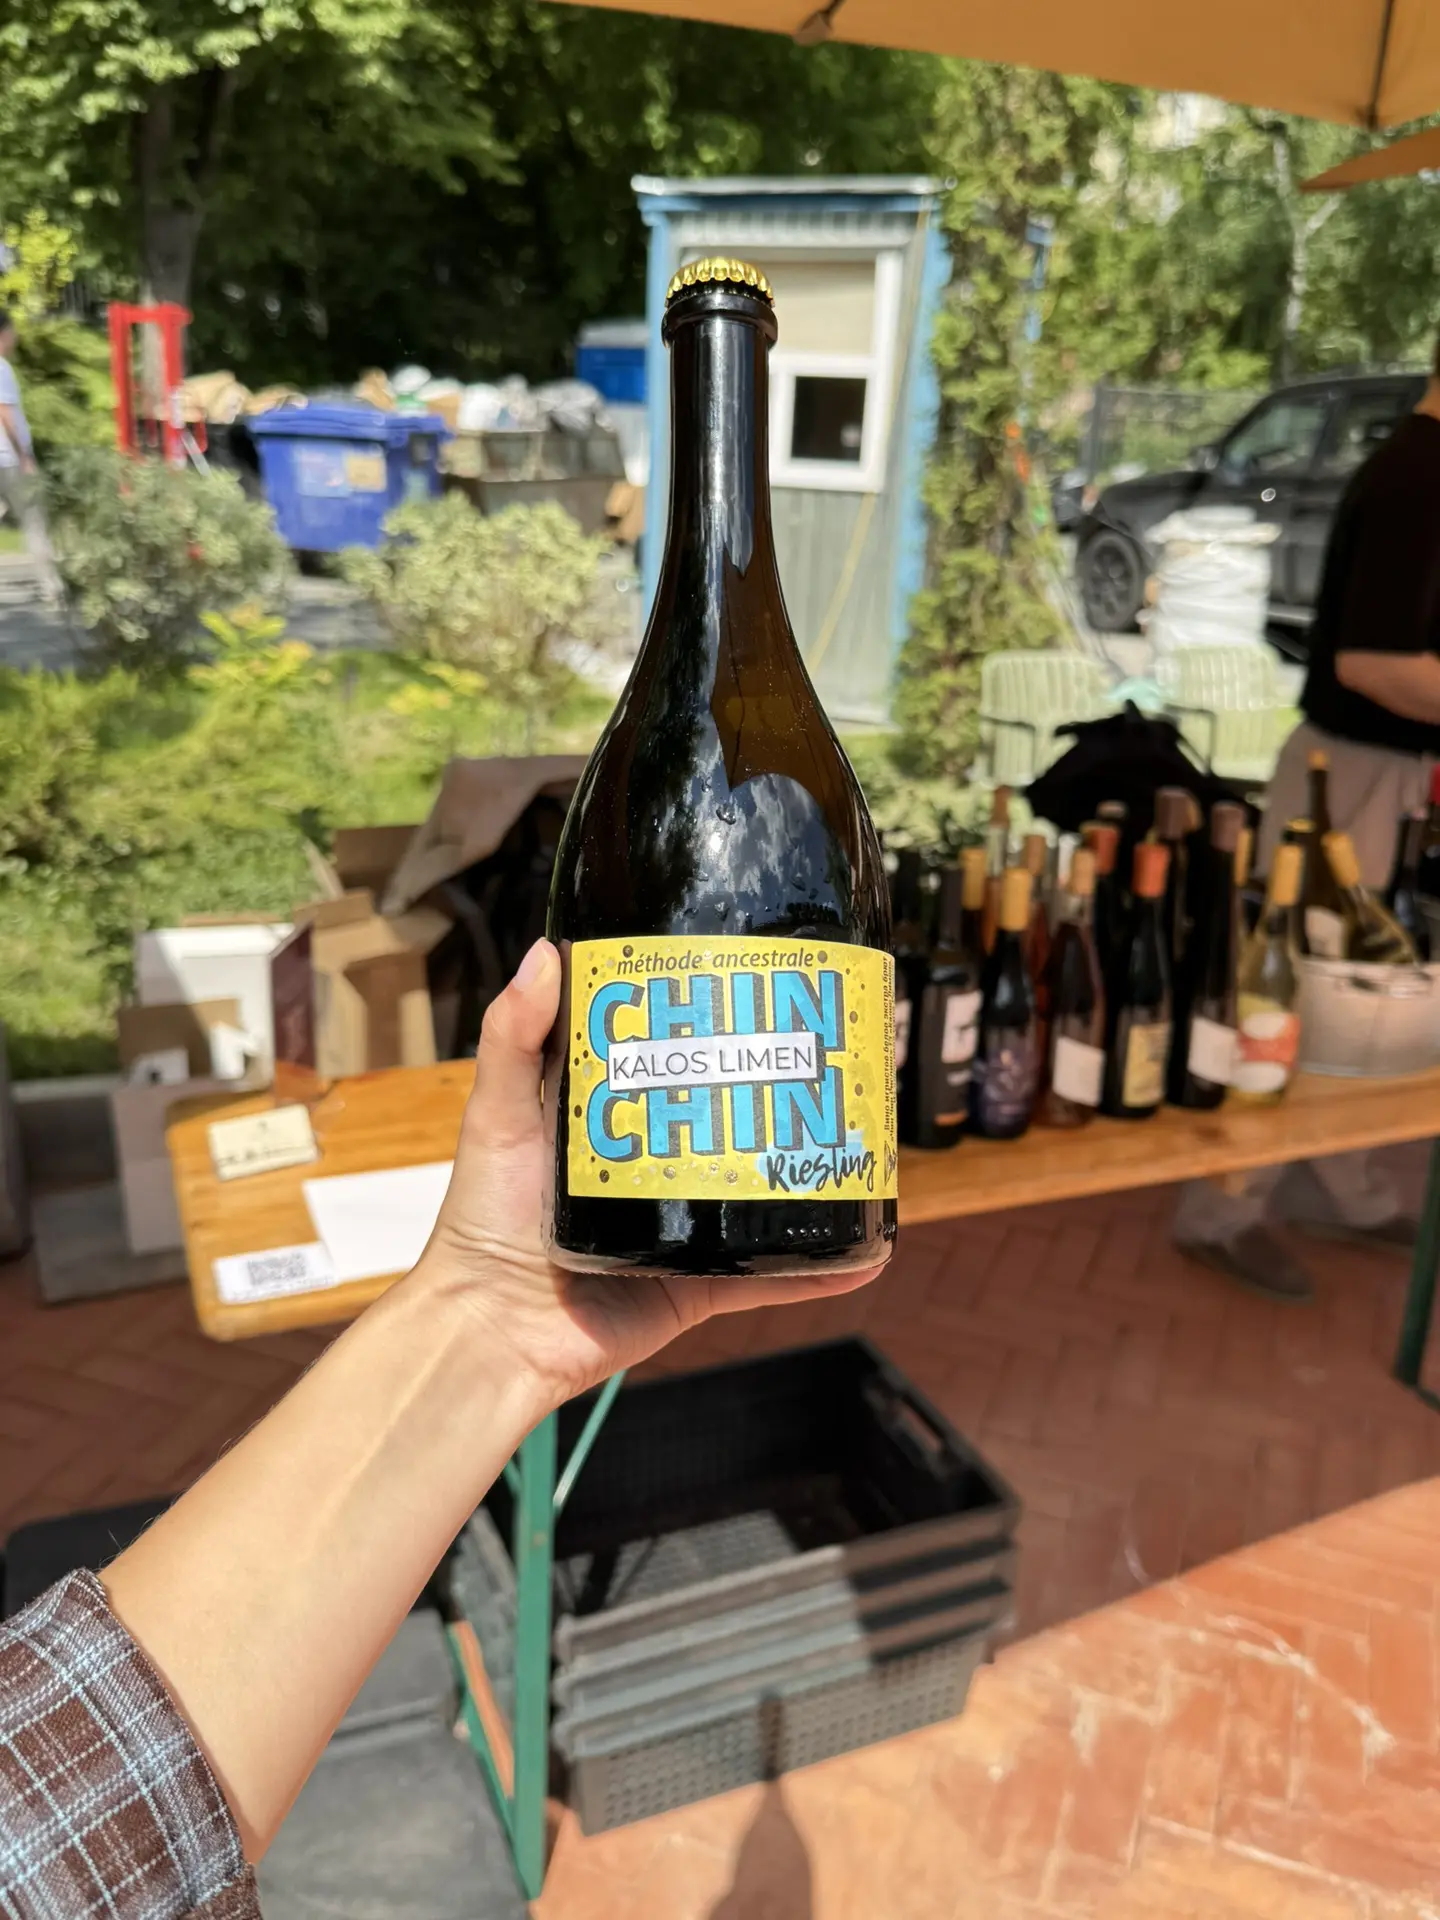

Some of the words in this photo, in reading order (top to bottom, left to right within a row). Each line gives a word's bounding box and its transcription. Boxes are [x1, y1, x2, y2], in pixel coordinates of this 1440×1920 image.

[617, 950, 702, 975] méthode
[712, 948, 814, 969] ancestrale
[588, 969, 846, 1062] CHIN
[612, 1050, 708, 1081] KALOS
[718, 1046, 813, 1075] LIMEN
[587, 1065, 846, 1162] CHIN
[766, 1147, 877, 1192] Riesling
